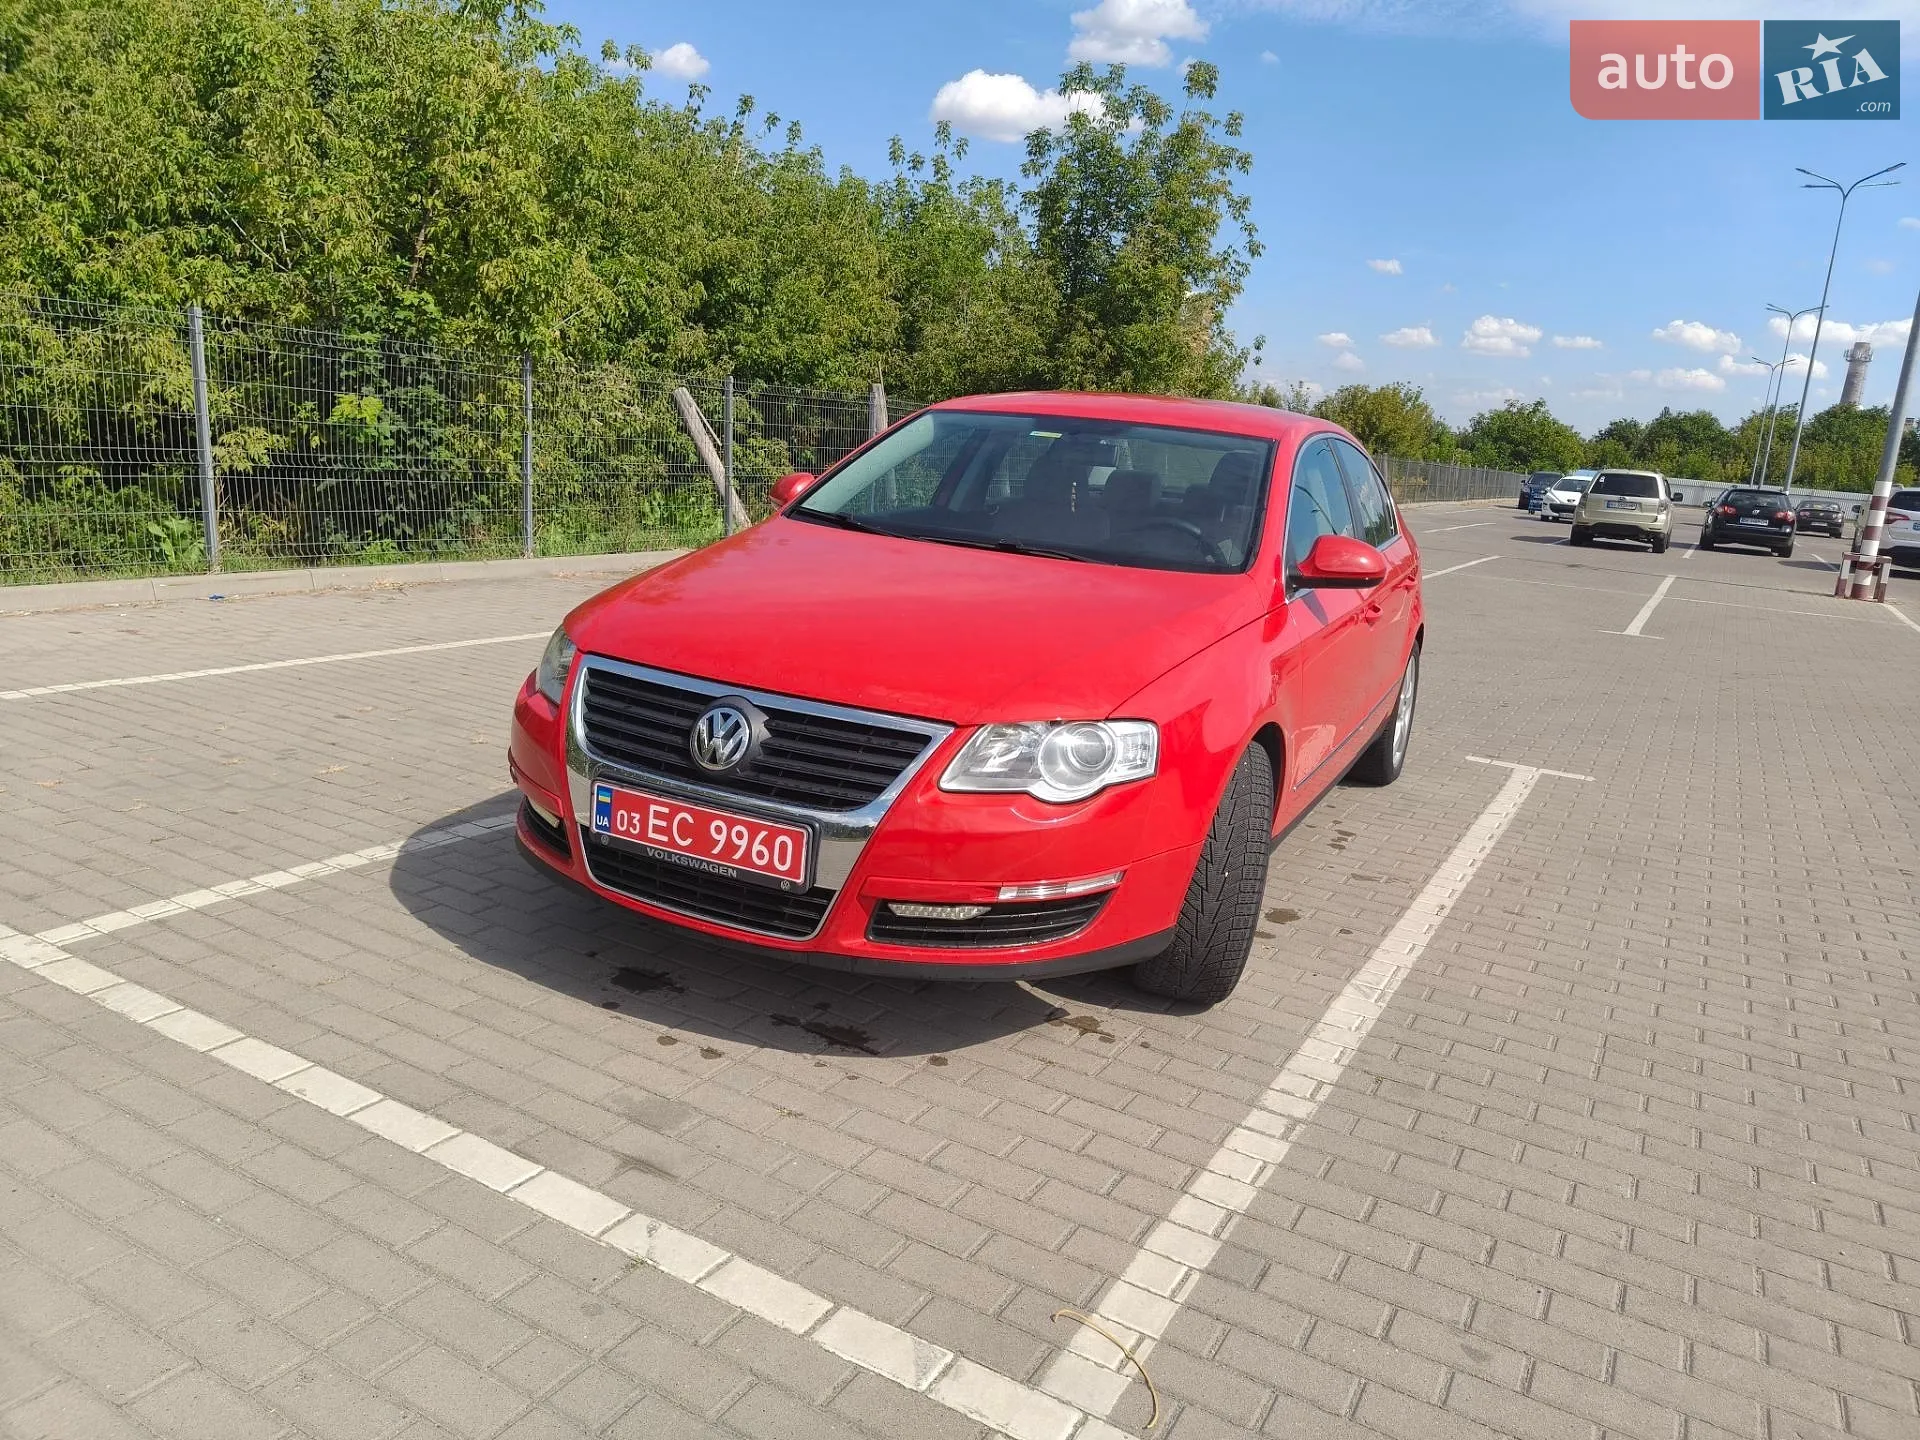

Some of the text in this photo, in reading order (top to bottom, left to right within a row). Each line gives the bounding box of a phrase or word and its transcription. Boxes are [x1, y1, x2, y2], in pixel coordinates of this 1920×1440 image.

[597, 815, 609, 828] UA
[616, 804, 793, 872] 03 EC 9960
[646, 847, 737, 878] VOLKSWAGEN
